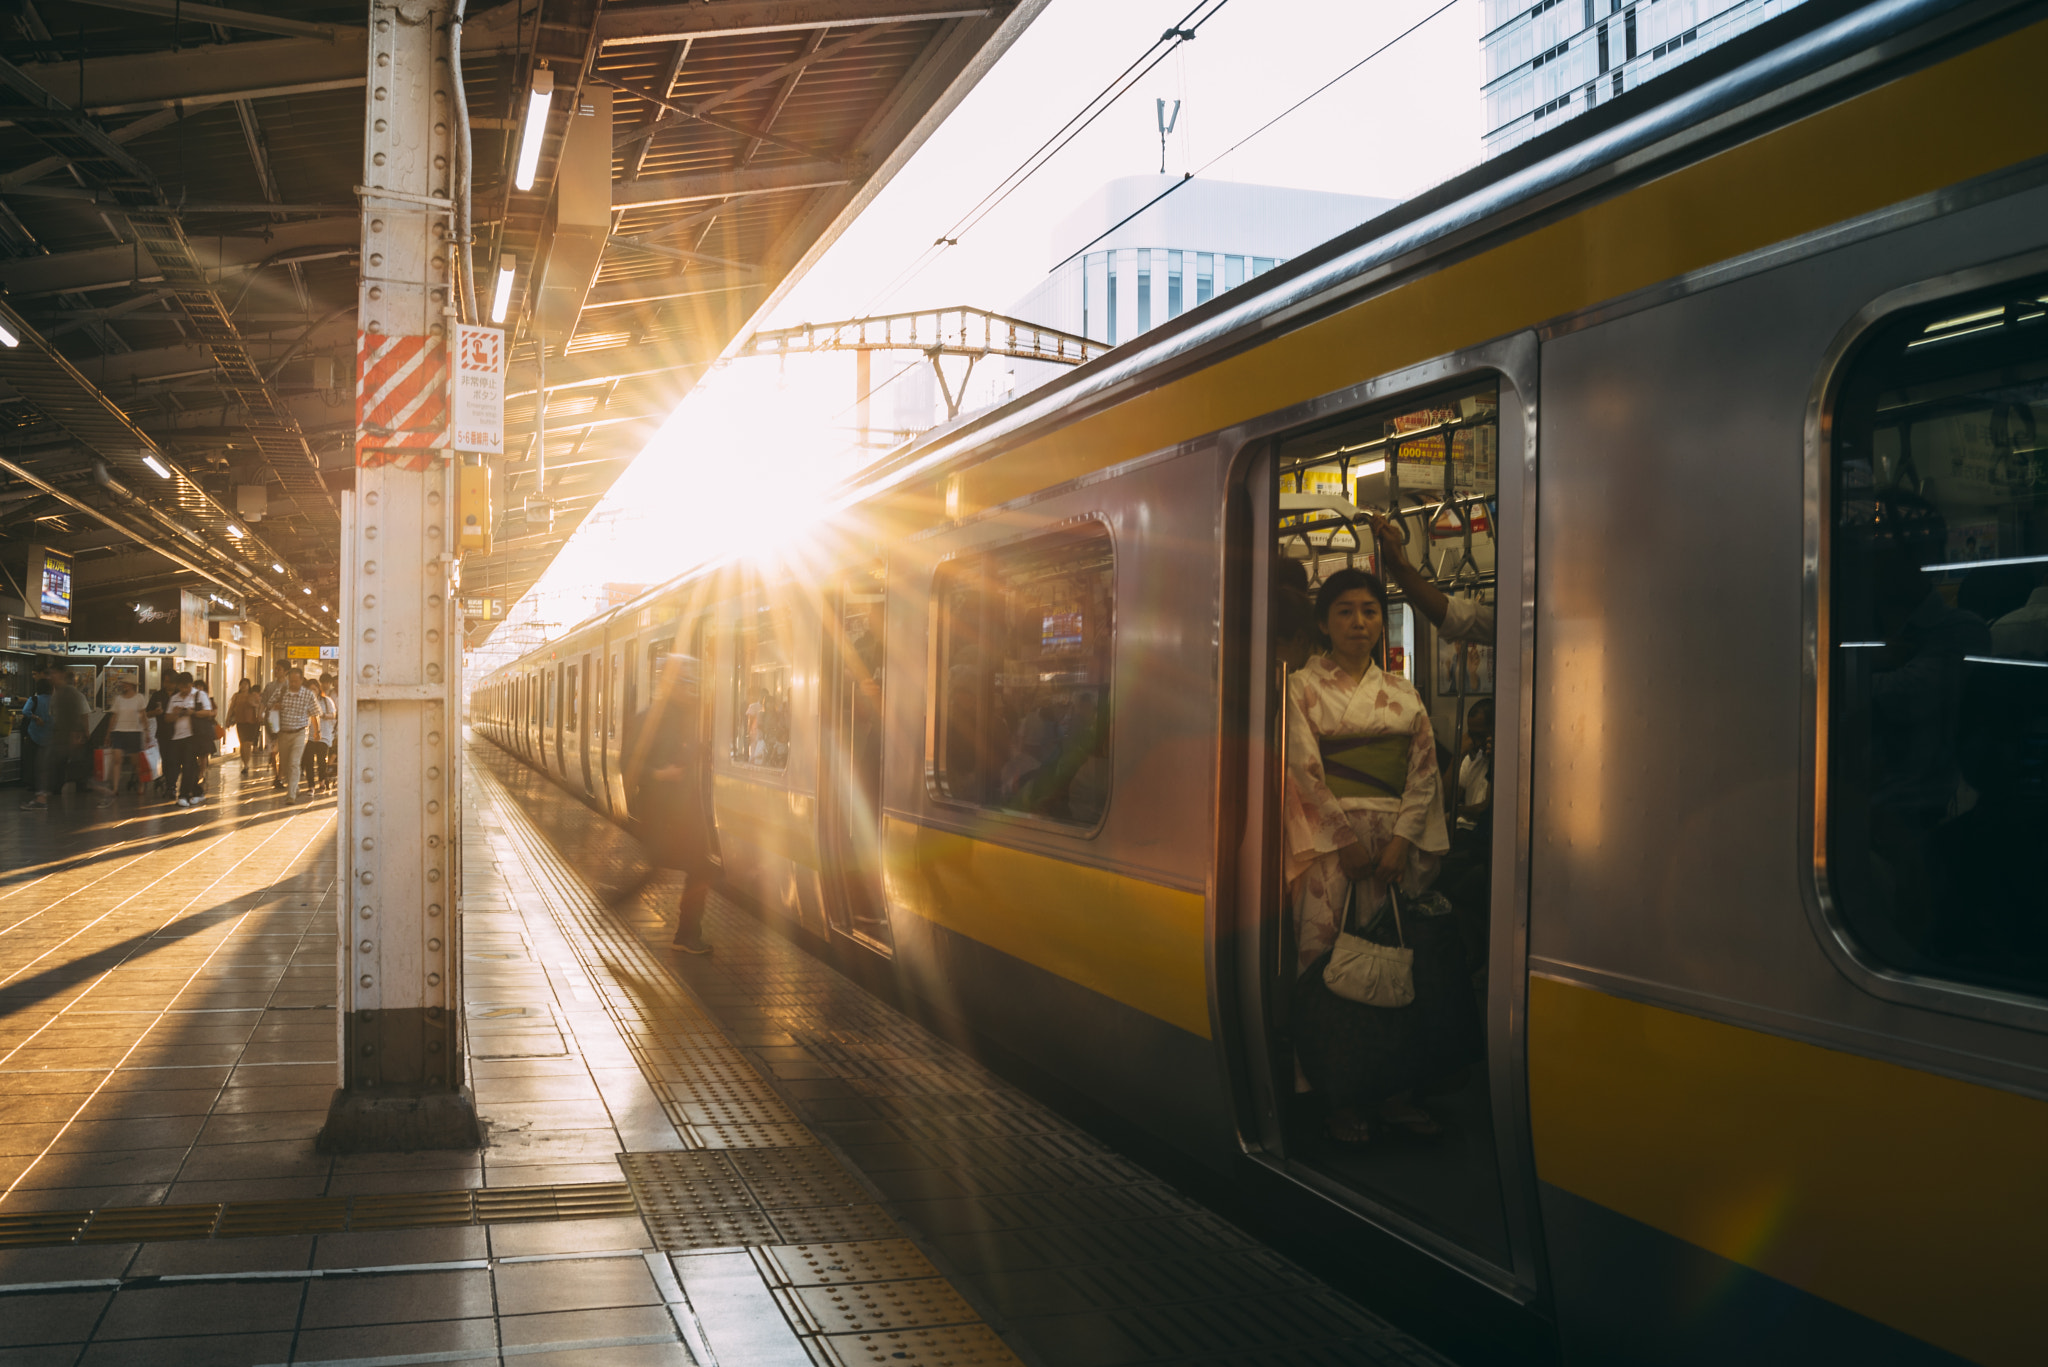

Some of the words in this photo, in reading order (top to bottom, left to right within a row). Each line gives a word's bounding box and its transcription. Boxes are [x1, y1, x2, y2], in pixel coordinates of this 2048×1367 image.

[461, 375, 497, 389] 非常停止
[473, 389, 497, 401] ボタン
[492, 600, 503, 616] 5
[121, 643, 178, 655] ステーション
